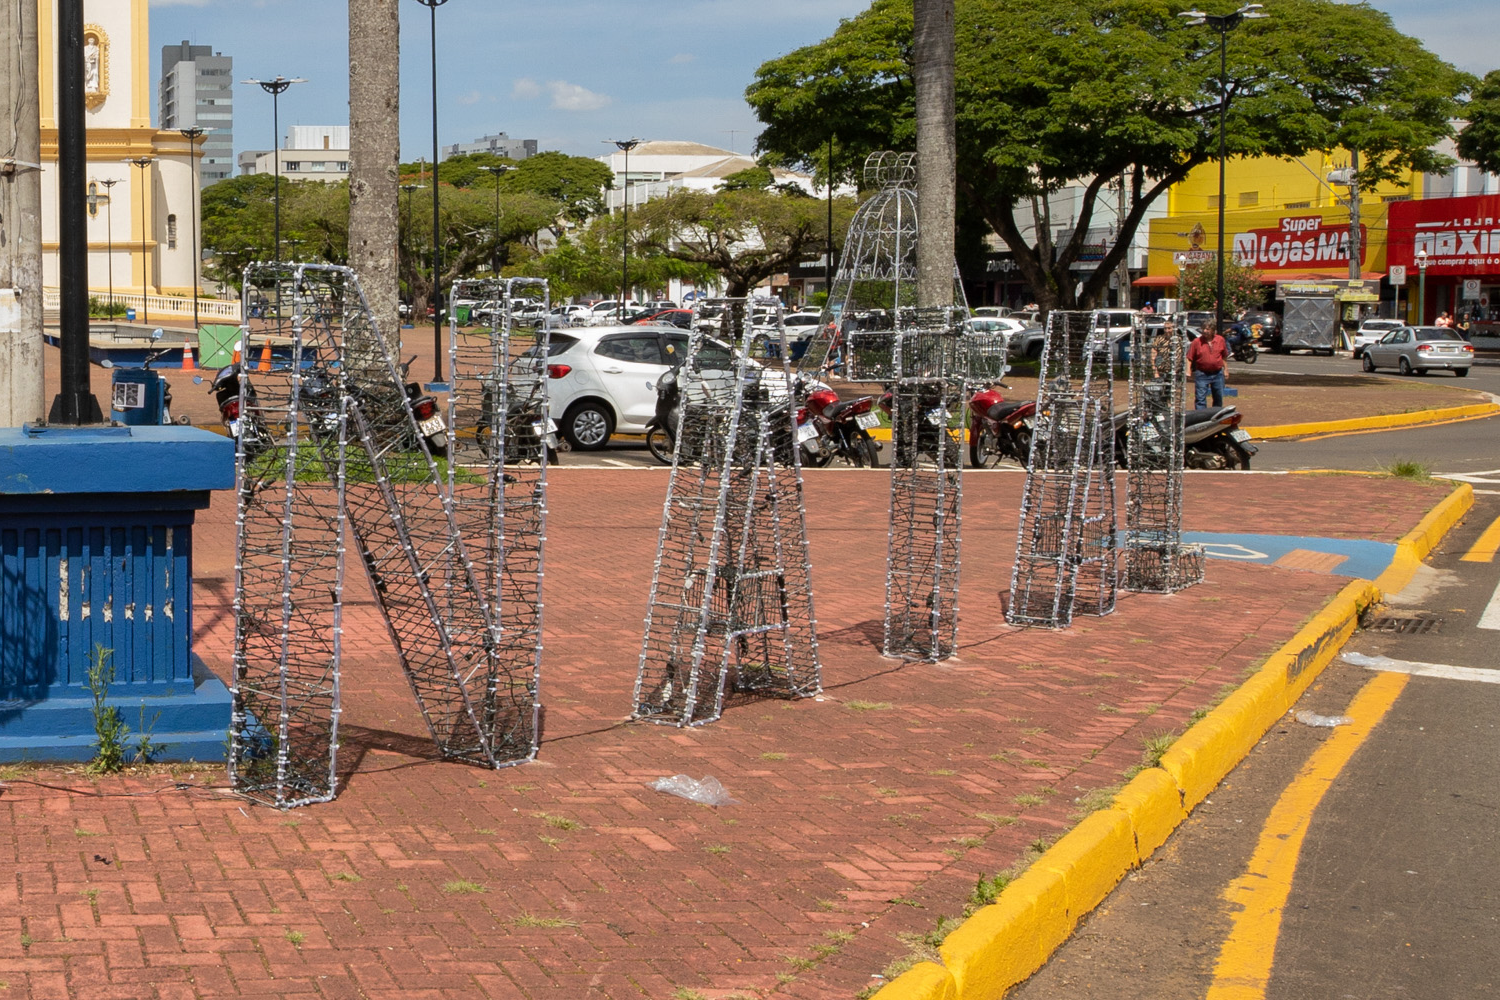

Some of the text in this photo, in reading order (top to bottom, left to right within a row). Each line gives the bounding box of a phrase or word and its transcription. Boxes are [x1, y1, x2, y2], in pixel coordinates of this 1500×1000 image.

[1281, 217, 1322, 236] Super
[1438, 258, 1467, 267] comprar
[1468, 258, 1485, 267] aqui
[229, 260, 1205, 810] NATAL
